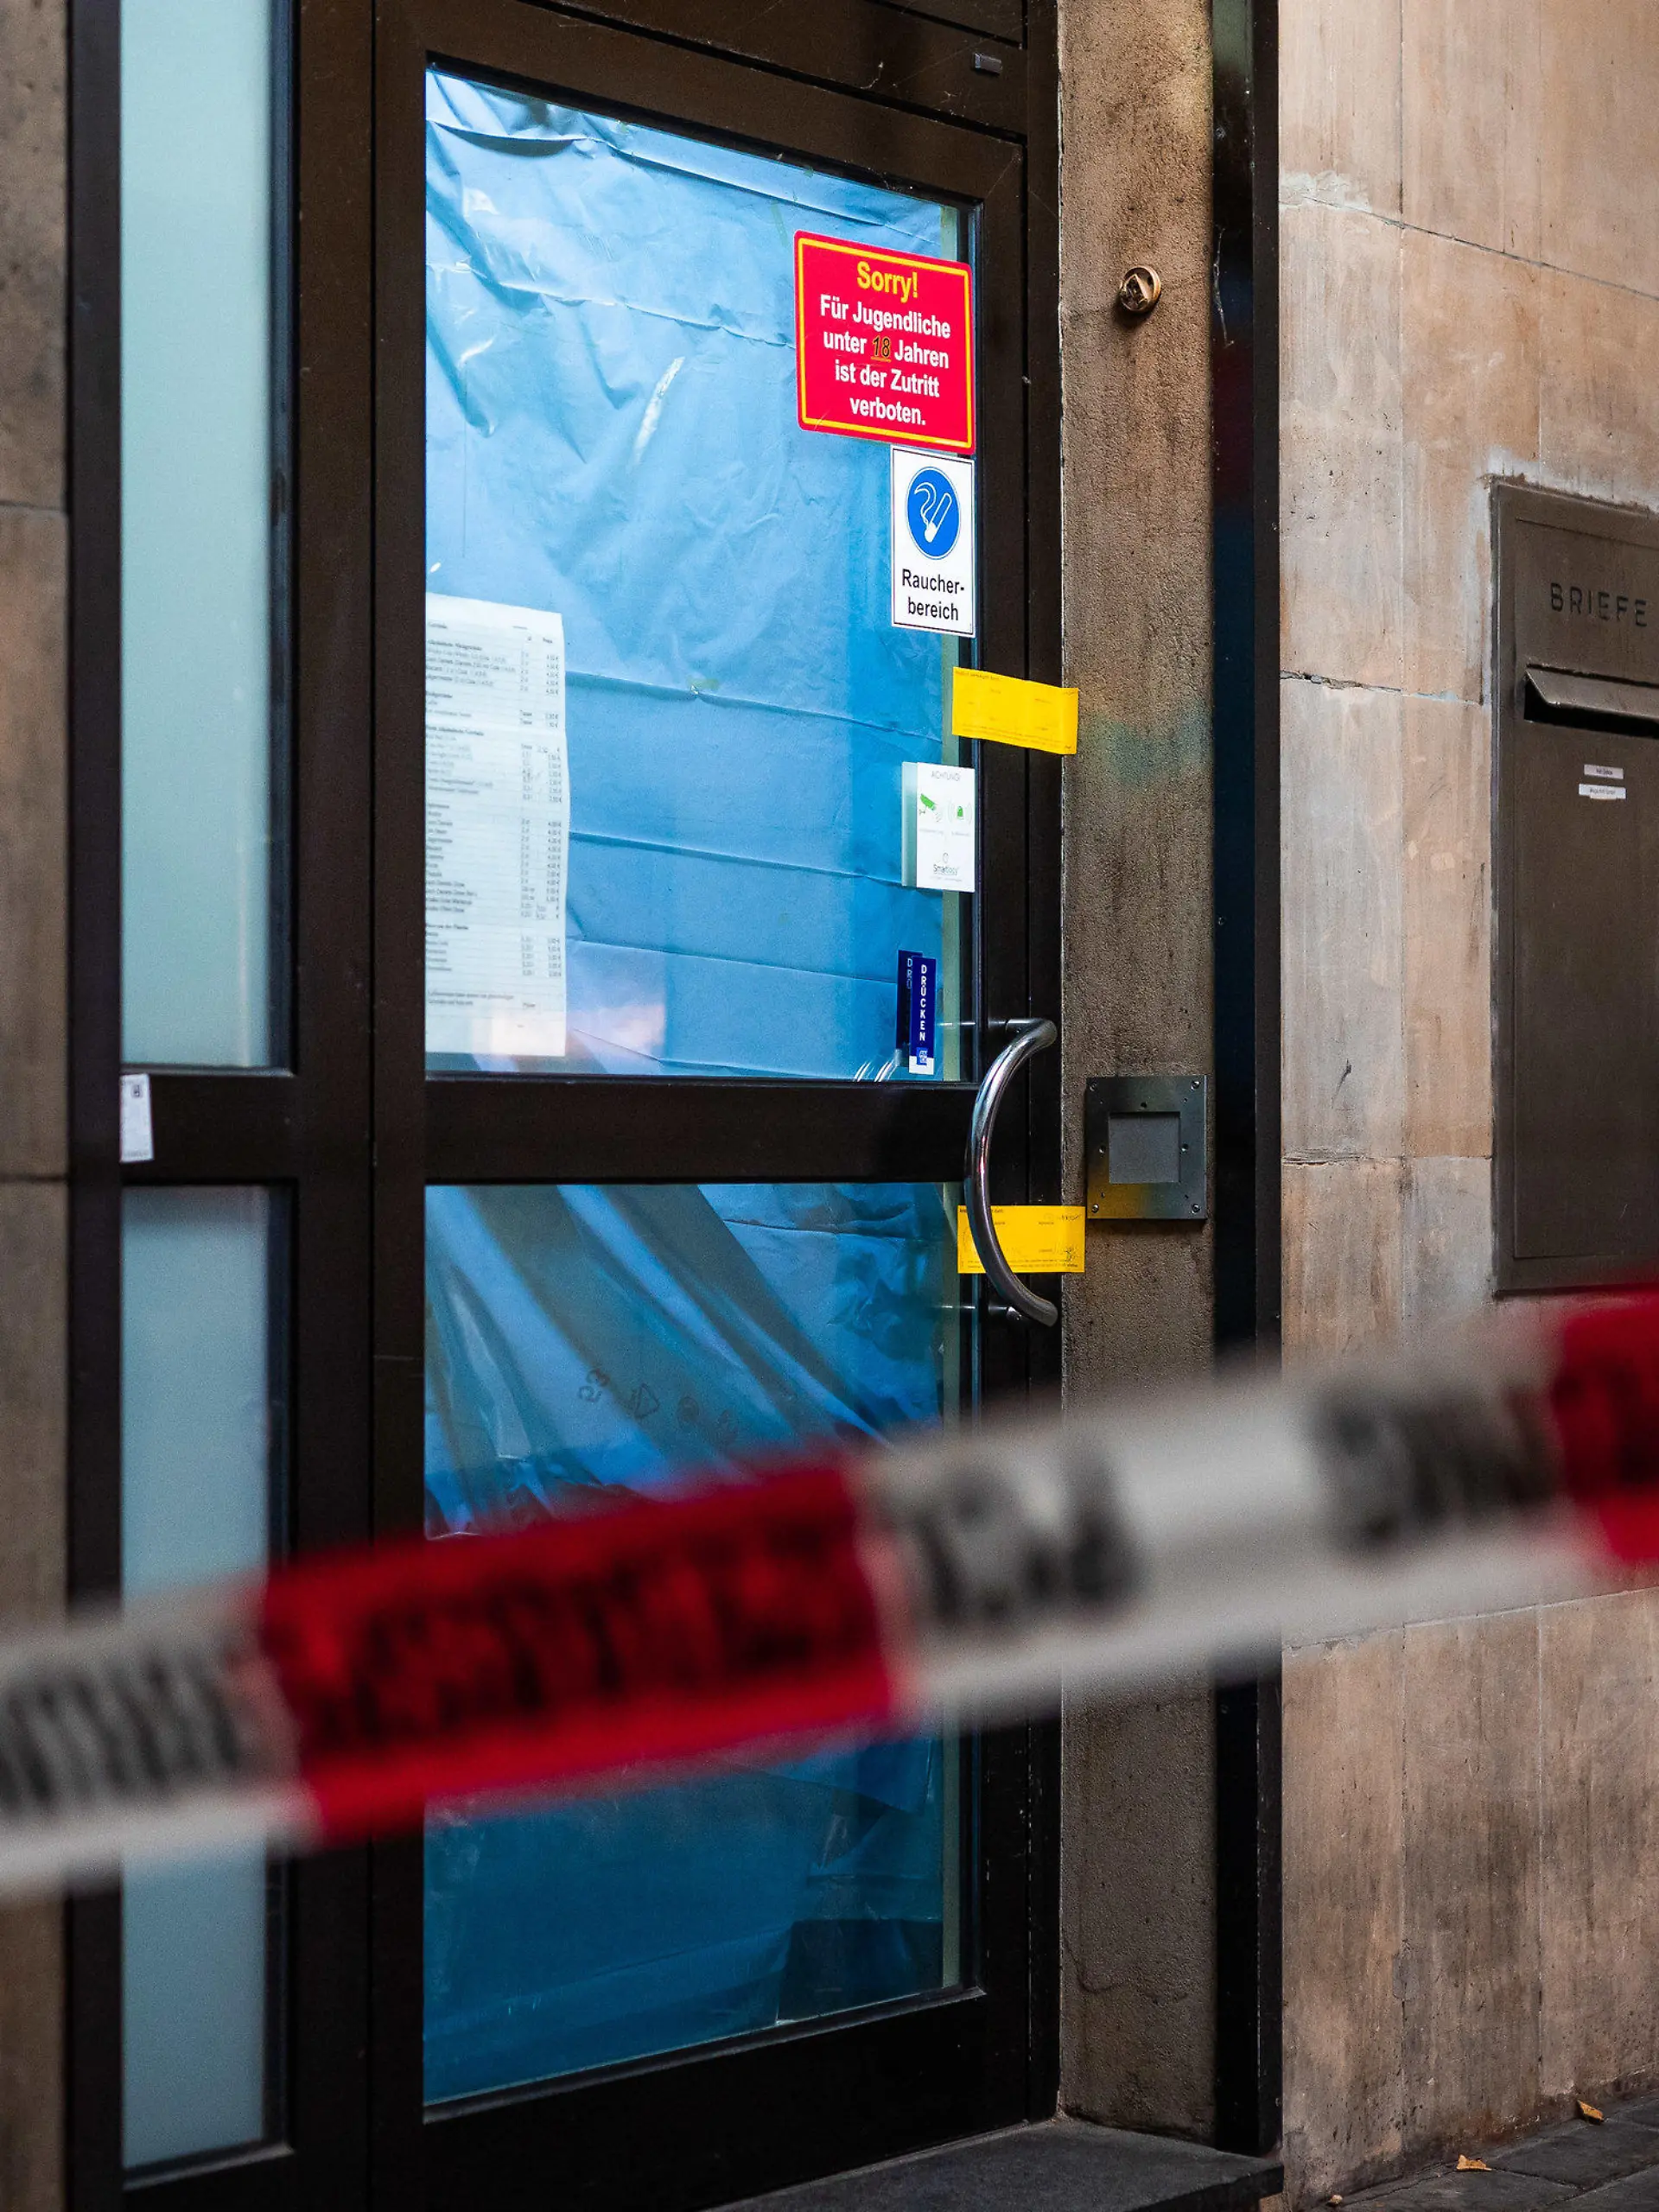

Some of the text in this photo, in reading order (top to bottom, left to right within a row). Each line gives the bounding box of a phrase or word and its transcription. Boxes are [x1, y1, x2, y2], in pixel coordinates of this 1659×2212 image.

[857, 261, 918, 302] Sorry!
[821, 294, 950, 339] Für Jugendliche
[823, 331, 949, 369] unter 18 Jahren
[836, 359, 939, 397] ist der Zutritt
[850, 397, 926, 425] verboten.
[902, 569, 964, 594] Raucher-
[908, 597, 958, 620] bereich
[1550, 582, 1647, 627] BRIEFE
